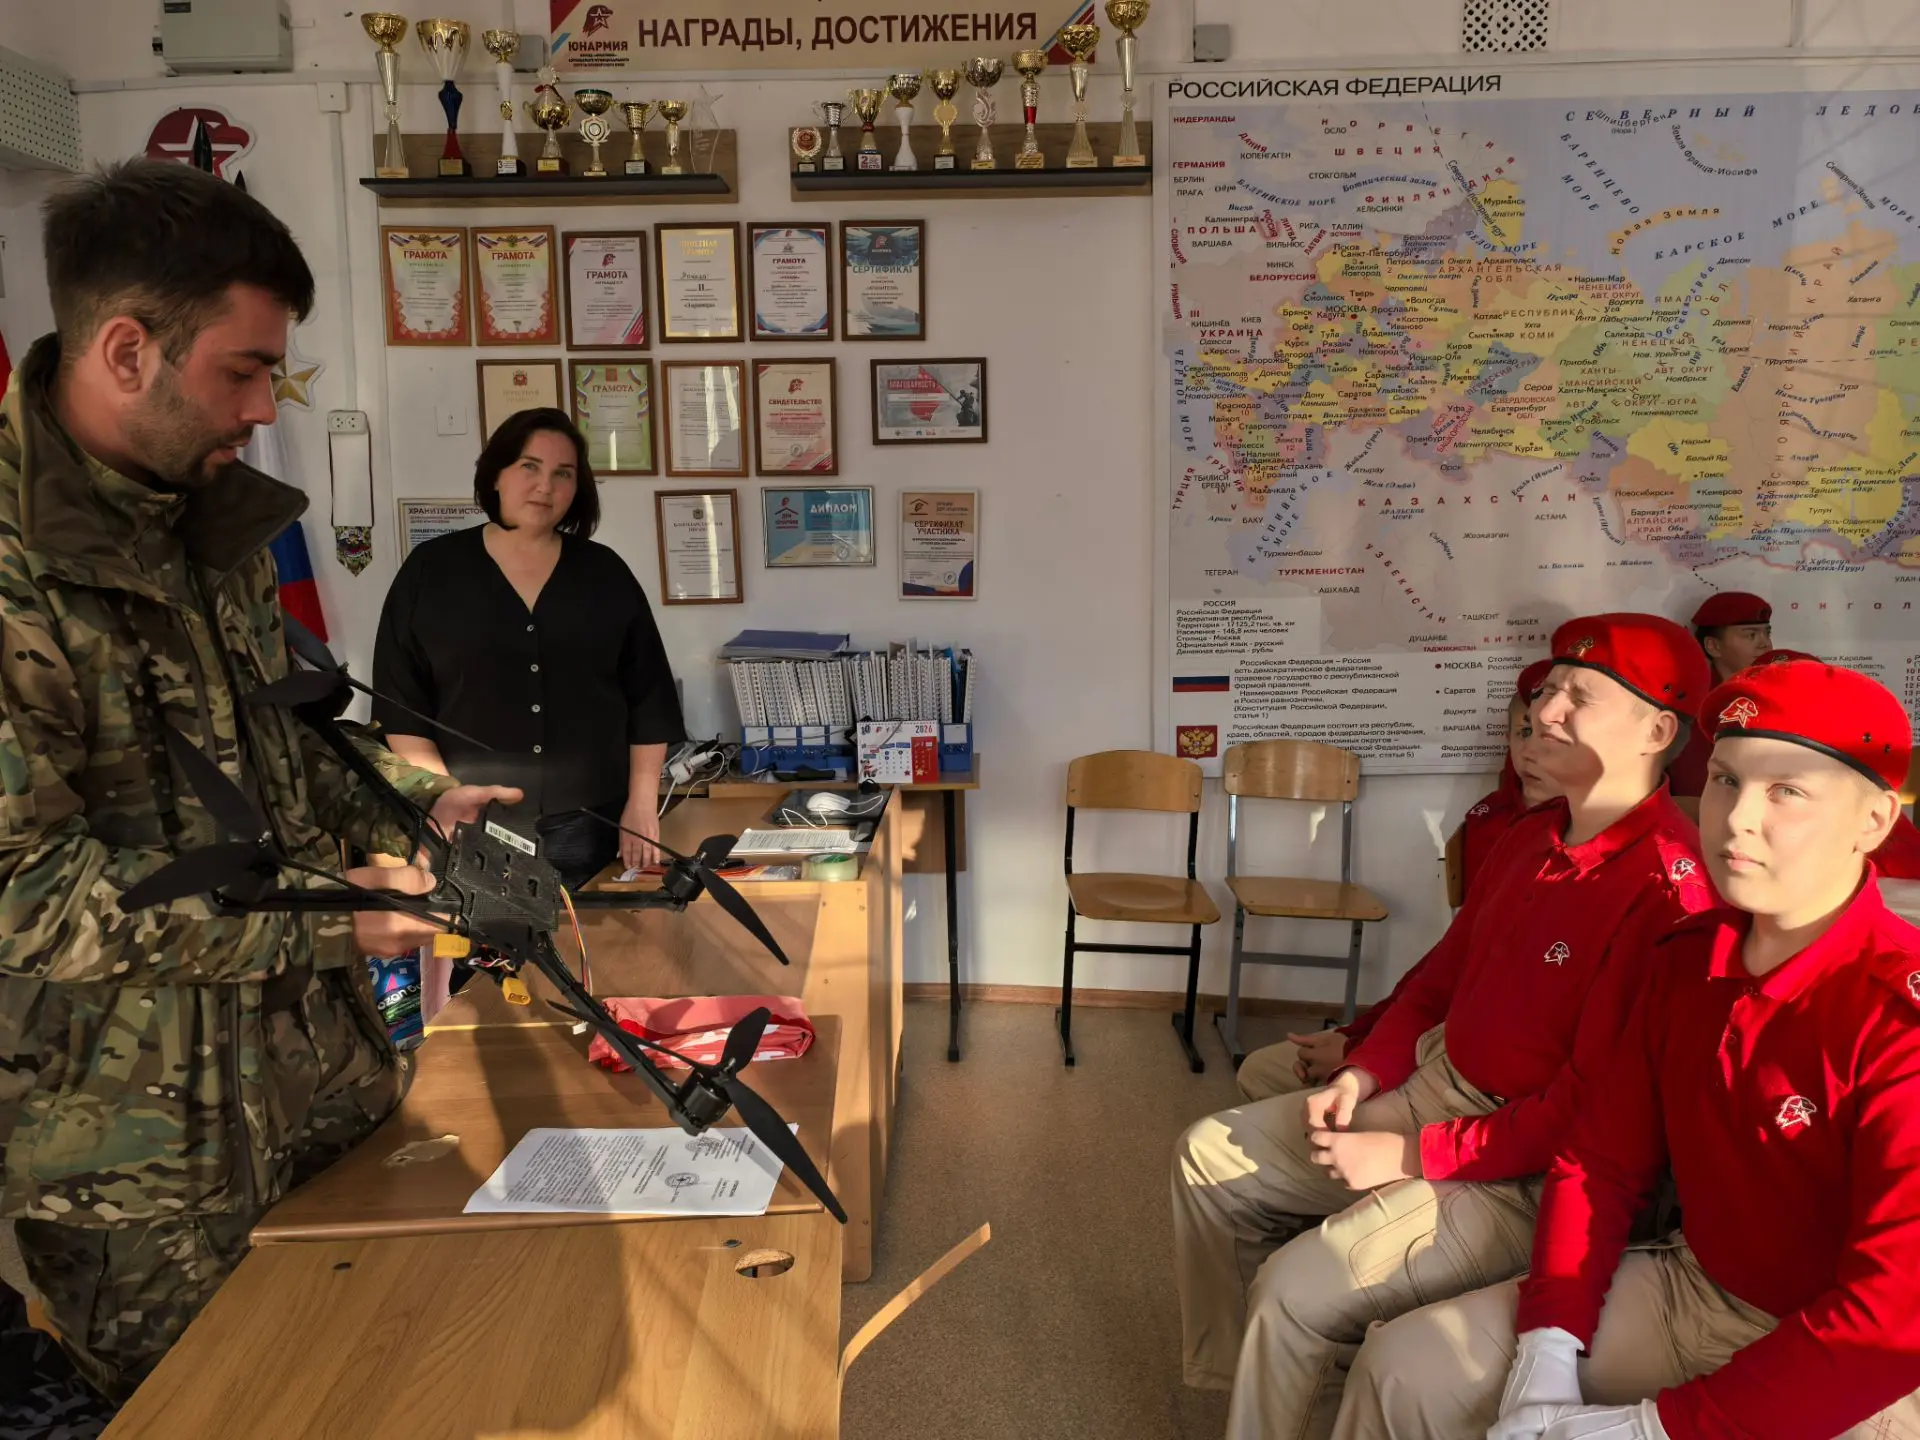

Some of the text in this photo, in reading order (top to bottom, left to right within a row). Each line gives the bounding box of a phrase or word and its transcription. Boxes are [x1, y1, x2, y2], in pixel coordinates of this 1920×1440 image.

[638, 12, 1037, 52] НАГРАДЫ, ДОСТИЖЕНИЯ
[568, 41, 628, 52] ЮНАРМИЯ
[1168, 74, 1501, 99] РОССИЙСКАЯ ФЕДЕРАЦИЯ
[1324, 127, 1347, 135] ОСЛО
[1238, 132, 1268, 152] ДАНИЯ
[1334, 145, 1440, 156] ШВЕЦИЯ
[1240, 152, 1291, 160] КОПЕНГАГЕН
[1172, 161, 1226, 169] ГЕРМАНИЯ
[1309, 172, 1357, 180] СТОКГОЛЬМ
[1483, 198, 1525, 206] Мурманск
[1187, 226, 1257, 234] ПОЛЬША
[1304, 229, 1327, 255] ЛАТВИЯ
[403, 250, 447, 260] ГРАМОТА
[491, 251, 535, 261] ГРАМОТА
[1341, 249, 1412, 258] Санкт-Петербург
[852, 265, 912, 274] СЕРТИФИКАТ
[586, 271, 628, 279] ГРАМОТА
[1574, 275, 1625, 283] Нарьян-Мар
[1578, 283, 1632, 291] НЕНЕЦКИЙ
[1283, 309, 1312, 317] Брянск
[1371, 306, 1418, 314] Ярославль
[1503, 308, 1583, 317] РЕСПУБЛИКА
[1292, 323, 1314, 331] Орёл
[1200, 329, 1263, 337] УКРАИНА
[1328, 365, 1357, 373] Тамбов
[592, 384, 634, 393] ГРАМОТА
[1376, 387, 1419, 395] Ульяновск
[1216, 402, 1261, 410] Краснодар
[1447, 405, 1465, 413] Уфа
[1515, 445, 1543, 453] Курган
[810, 503, 857, 514] ДИПЛОМ
[914, 520, 964, 528] СЕРТИФИКАТ
[1278, 567, 1365, 576] ТУРКМЕНИСТАН
[1318, 586, 1360, 594] АШХАБАД
[1444, 687, 1476, 695] Саратов
[377, 989, 407, 1010] ozon
